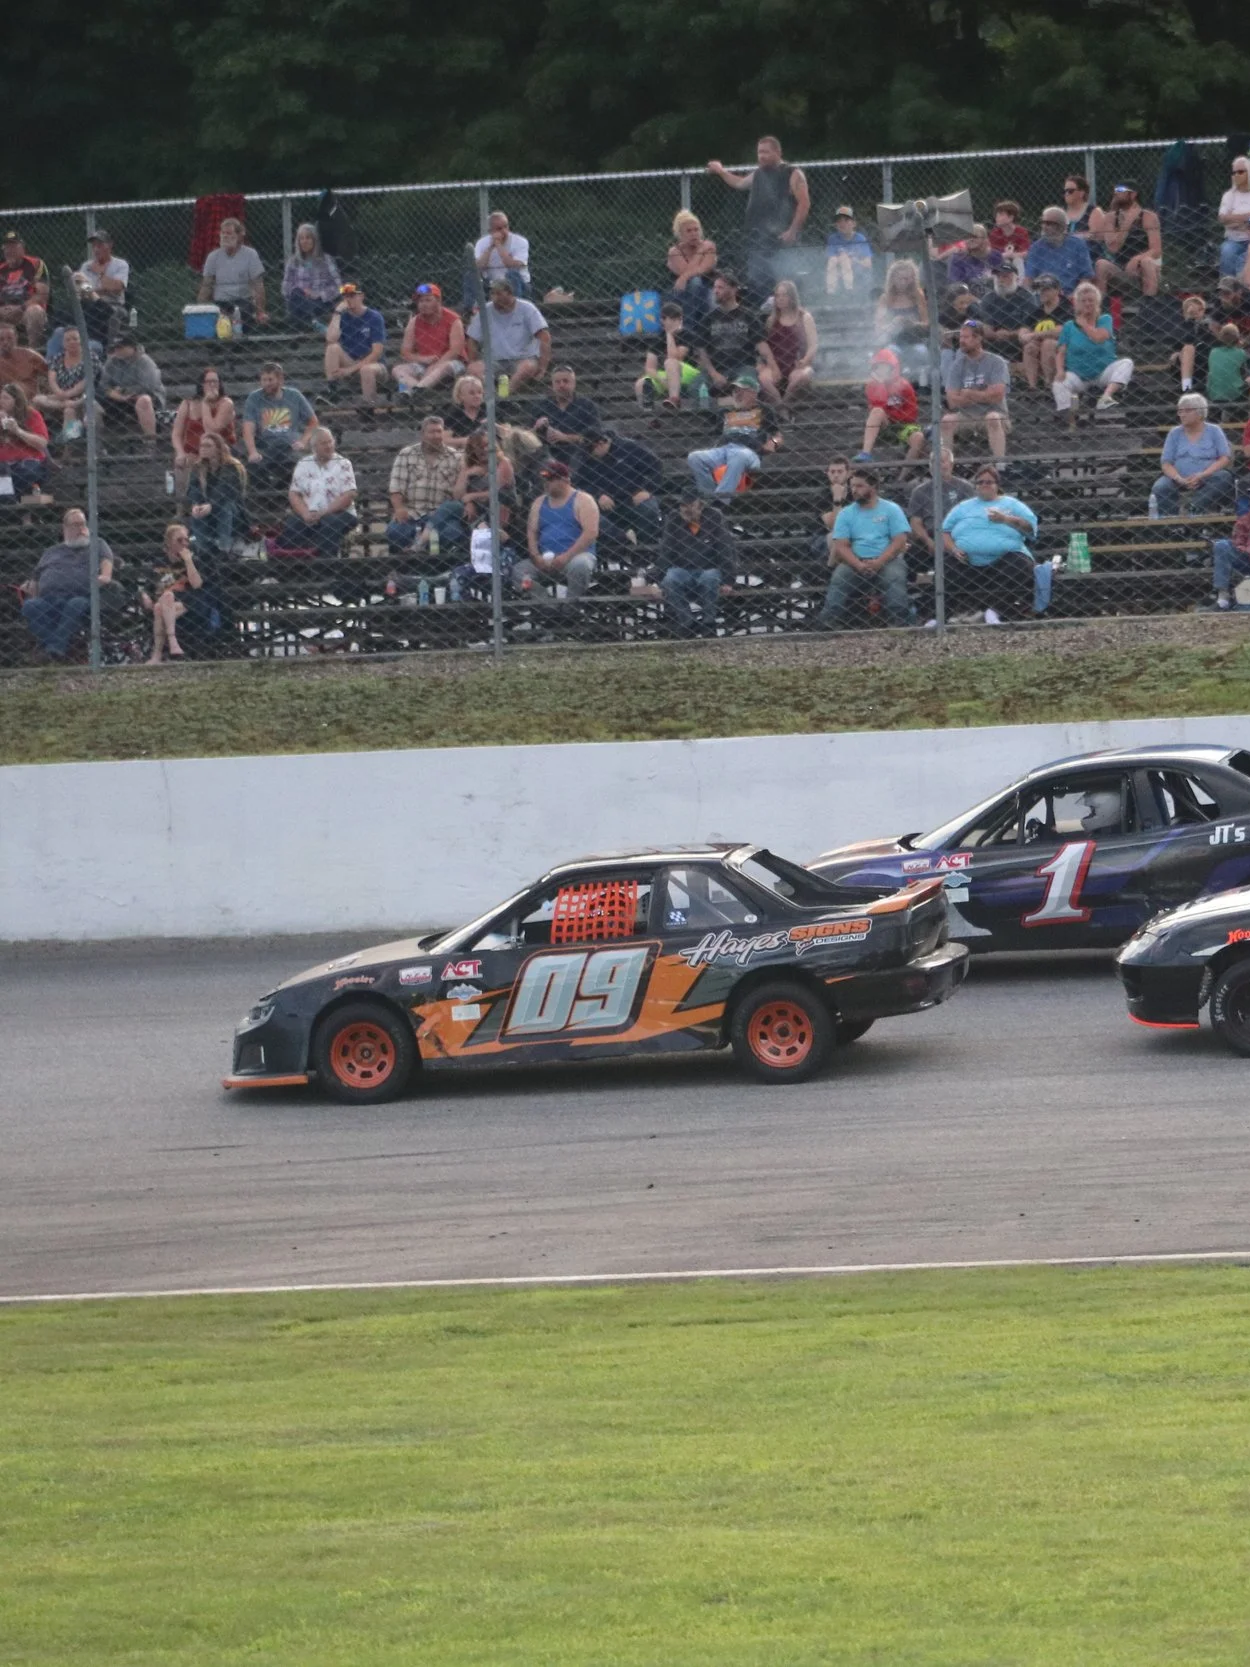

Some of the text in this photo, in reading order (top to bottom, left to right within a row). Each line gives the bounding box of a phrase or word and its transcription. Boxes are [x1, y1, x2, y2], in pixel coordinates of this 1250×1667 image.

[1209, 823, 1246, 845] JT's
[934, 852, 973, 870] ACT
[1022, 840, 1097, 928] 1
[679, 918, 872, 968] Hayes SIGNS
[814, 933, 866, 945] DESIGNS
[441, 960, 483, 980] ACT
[503, 946, 653, 1037] 09
